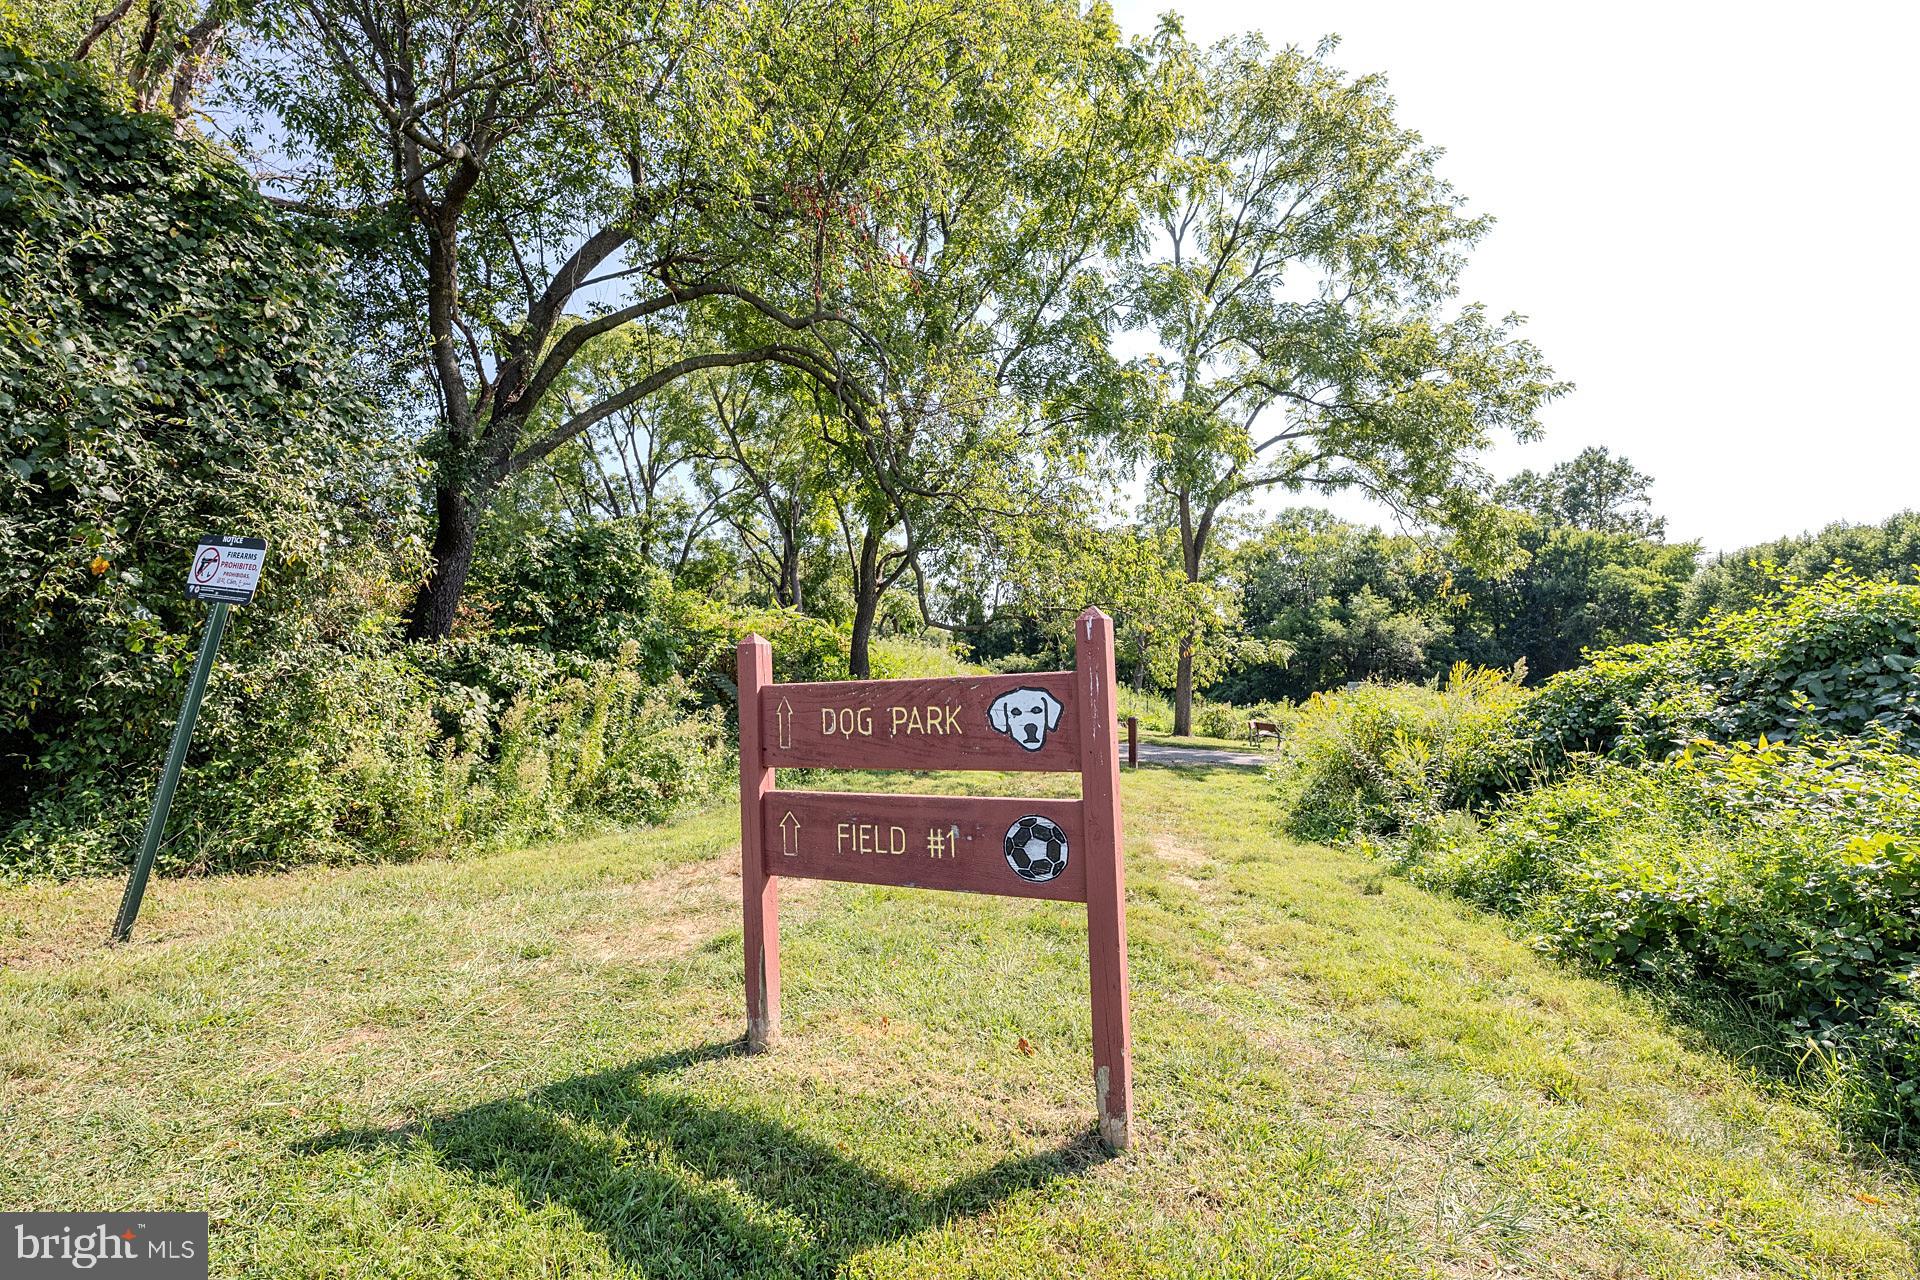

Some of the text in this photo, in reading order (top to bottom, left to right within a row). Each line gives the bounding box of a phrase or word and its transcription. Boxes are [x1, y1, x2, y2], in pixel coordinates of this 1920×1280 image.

[222, 536, 244, 544] NOTICE
[227, 551, 258, 561] FIREARMS
[821, 705, 963, 737] DOG PARK
[837, 823, 957, 859] FIELD #1
